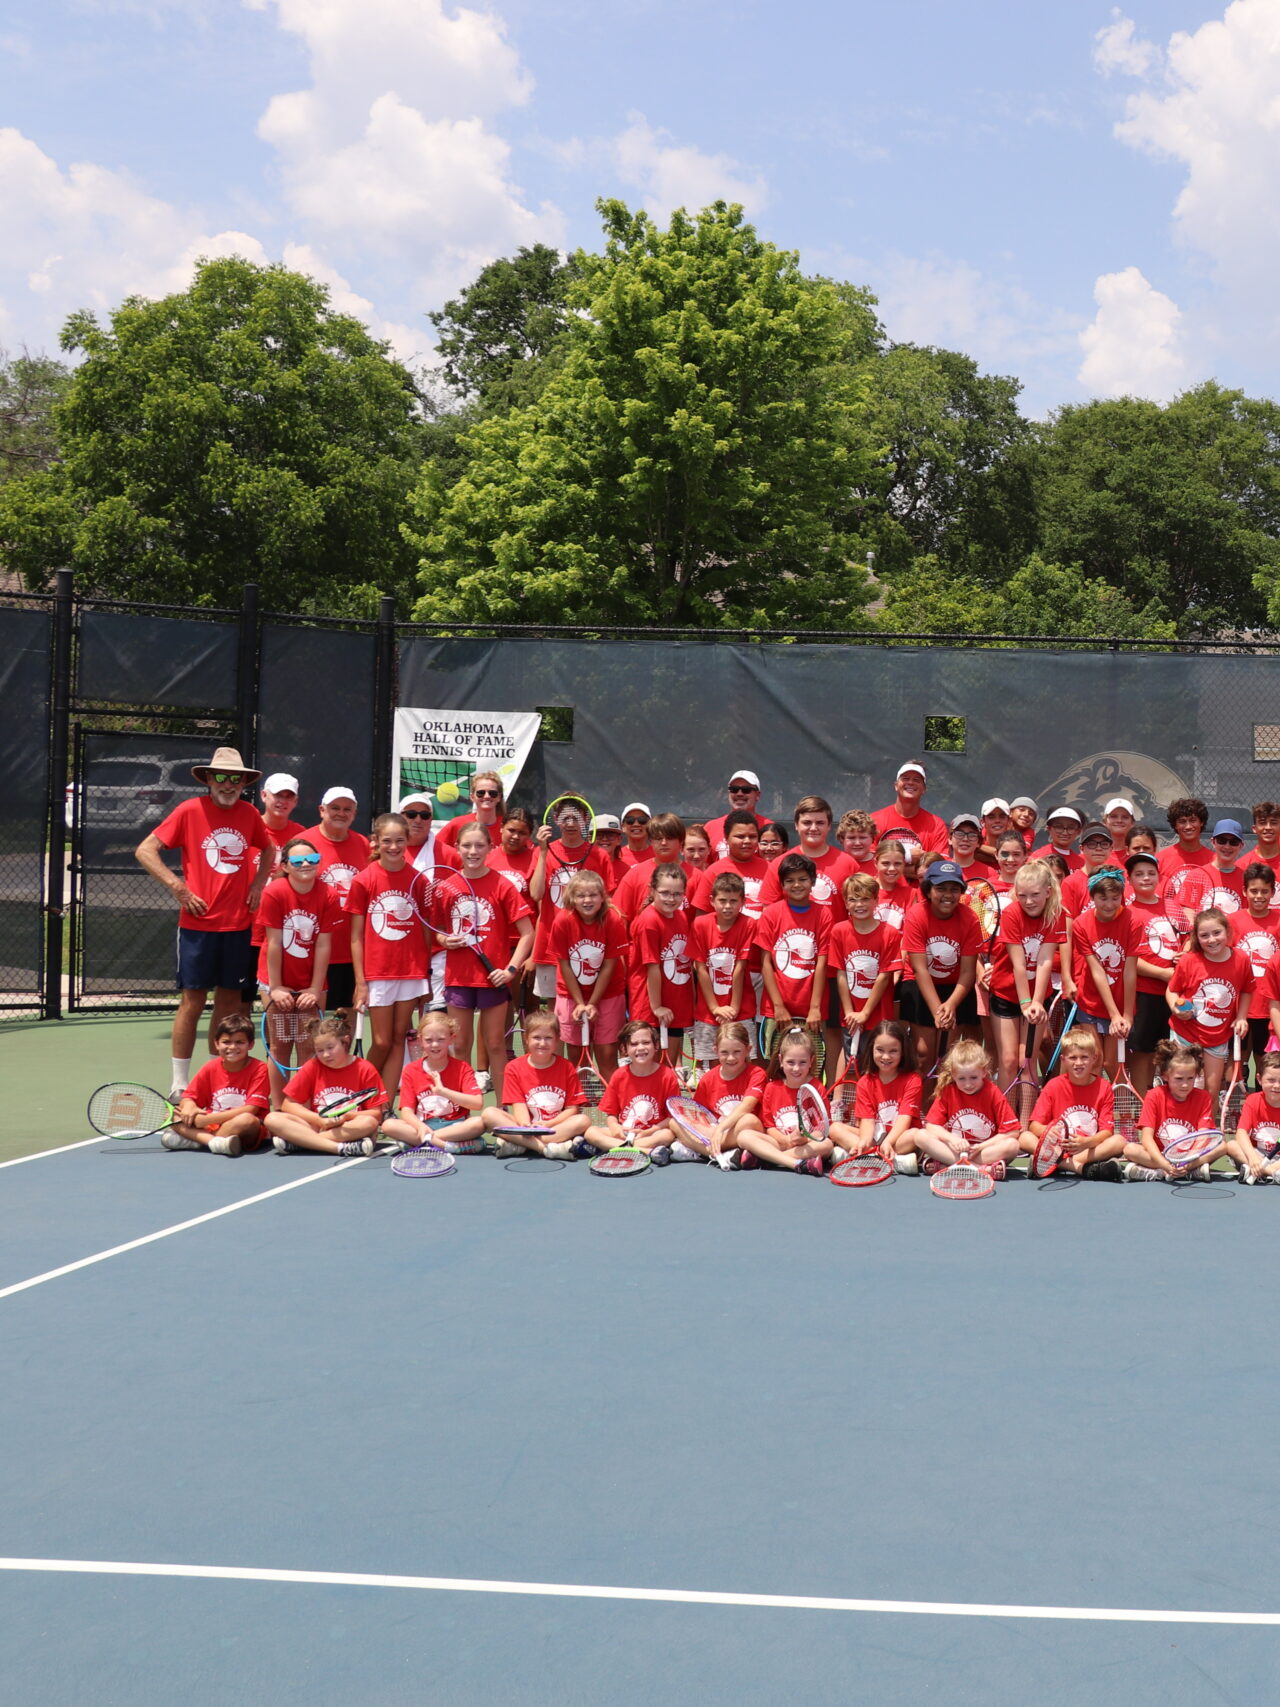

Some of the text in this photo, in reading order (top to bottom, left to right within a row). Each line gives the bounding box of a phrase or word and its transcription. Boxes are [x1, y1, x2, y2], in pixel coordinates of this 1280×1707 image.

[414, 732, 514, 746] HALL OF FAME
[423, 721, 505, 734] OKLAHOMA
[412, 744, 516, 759] TENNIS CLINIC
[201, 827, 249, 850] OKLAHOMA TENNIS
[367, 891, 402, 914] OKLAHOMA
[478, 896, 496, 920] TENNIS
[622, 1094, 650, 1119] OKLAHOMA
